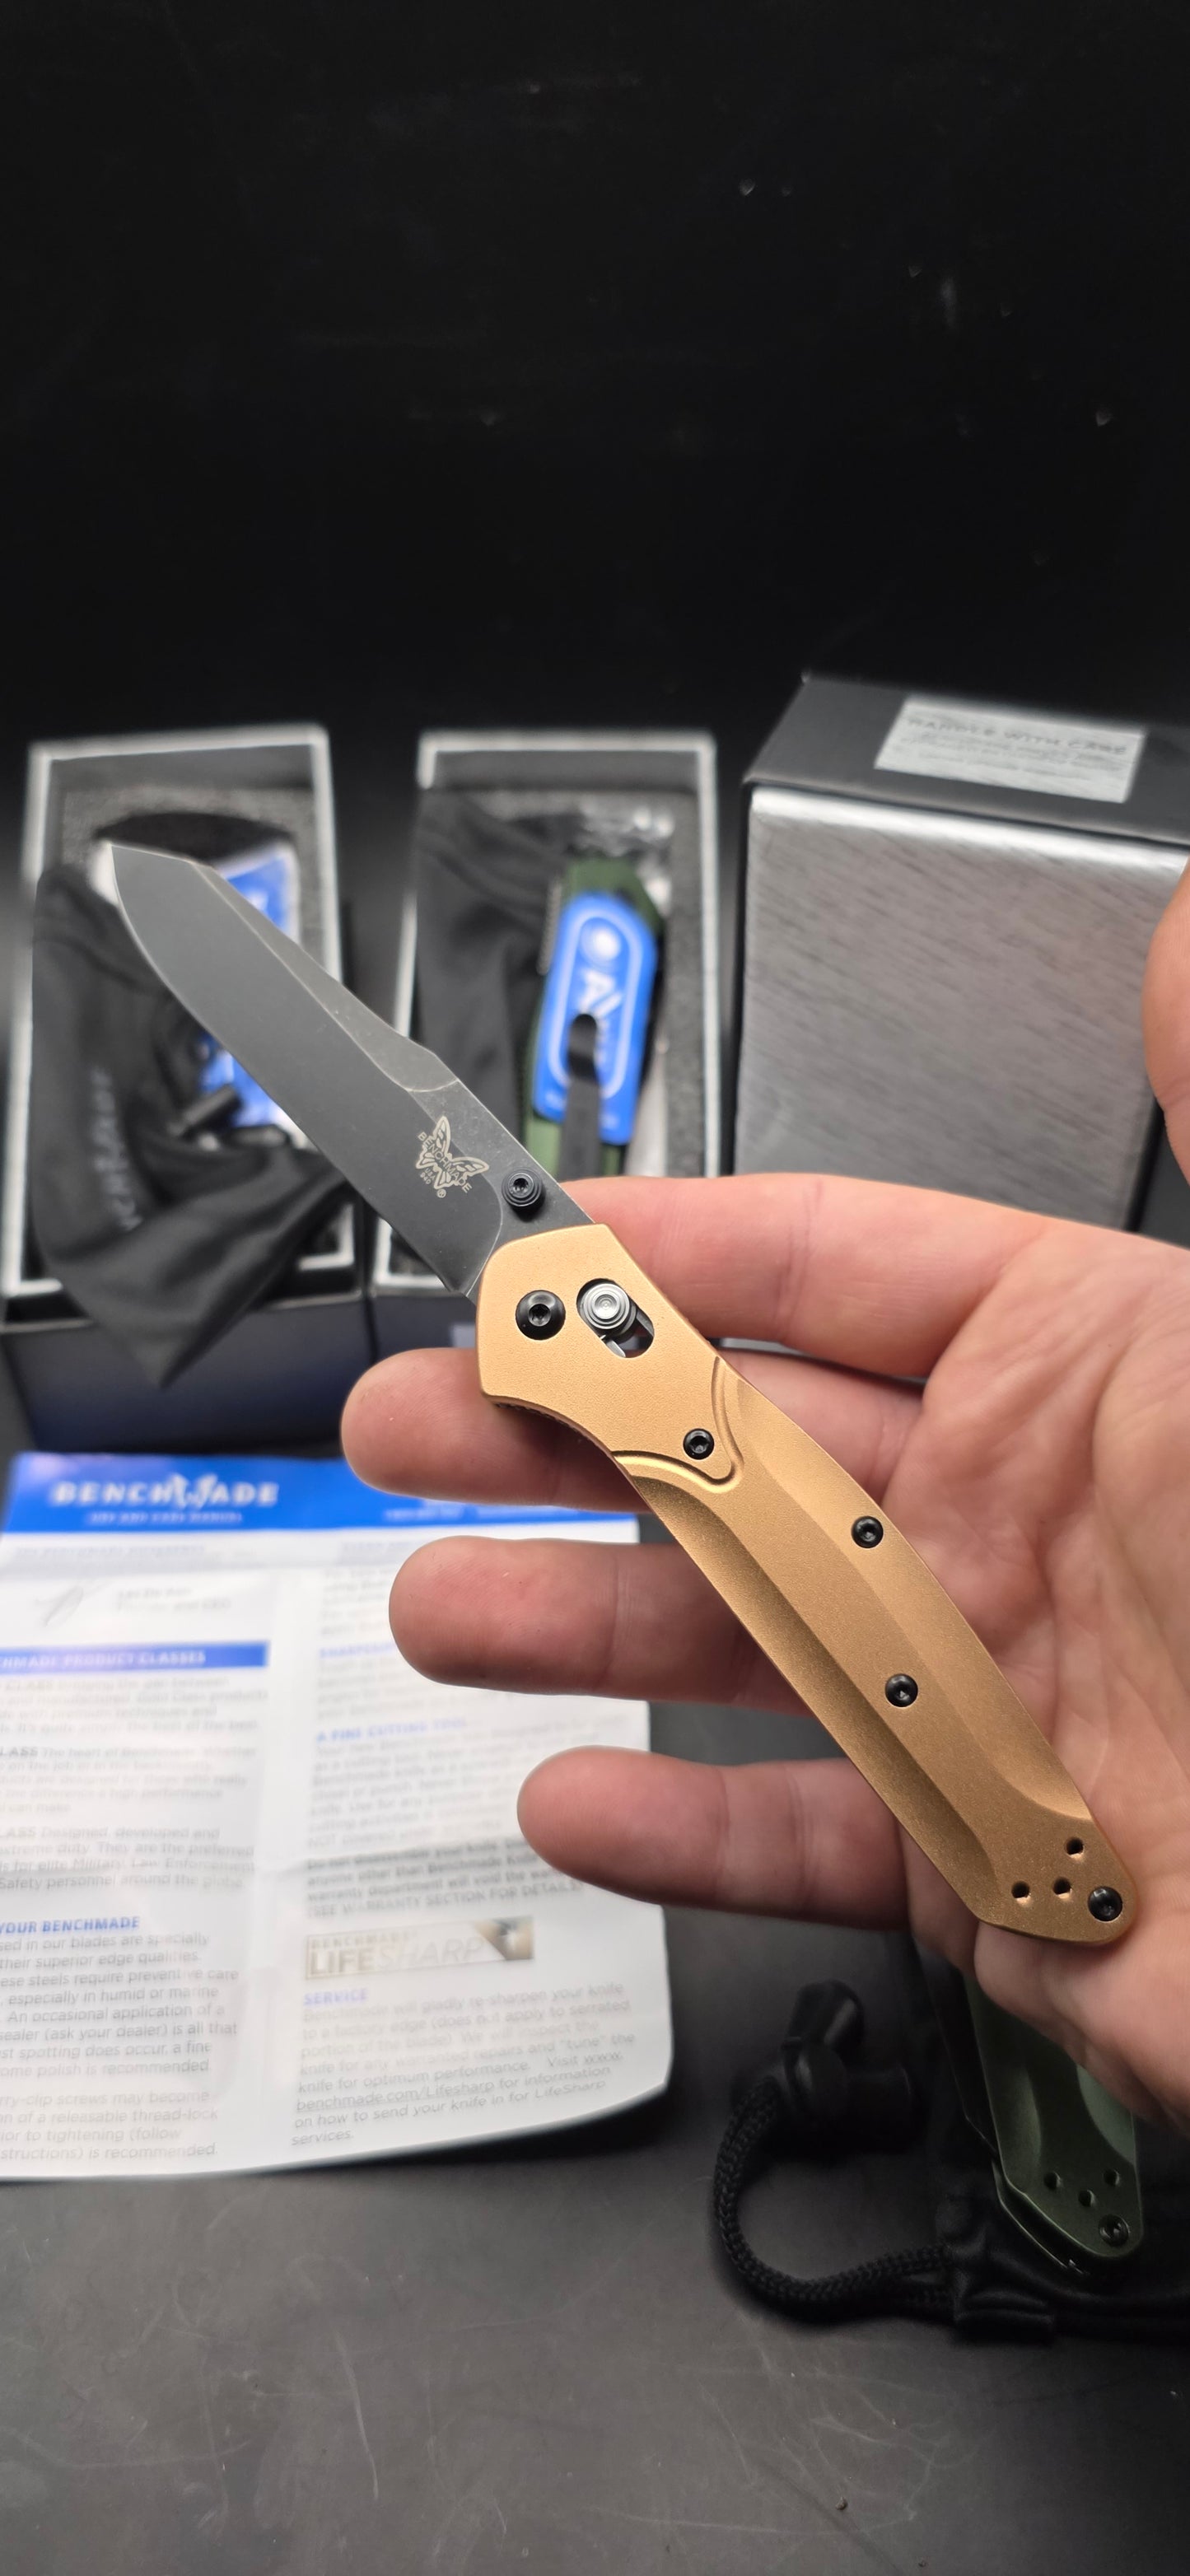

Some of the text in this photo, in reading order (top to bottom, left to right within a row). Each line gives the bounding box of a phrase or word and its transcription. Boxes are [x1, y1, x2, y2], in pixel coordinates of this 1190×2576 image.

[1003, 730, 1060, 746] WITH
[1067, 740, 1127, 755] CARE
[418, 1132, 473, 1193] BENCHMADE
[193, 1826, 221, 1839] and
[134, 1842, 158, 1853] are
[161, 1841, 185, 1853] the
[46, 1873, 117, 1892] personnel
[120, 1872, 171, 1886] around
[175, 1872, 198, 1885] the
[42, 1916, 140, 1933] BENCHMADE
[26, 1938, 39, 1951] in
[43, 1939, 66, 1950] our
[71, 1935, 117, 1949] blades
[121, 1935, 144, 1947] are
[35, 1954, 94, 1970] superior
[98, 1952, 134, 1967] edge
[28, 1972, 71, 1986] steels
[74, 1971, 124, 1987] require
[208, 1968, 240, 1981] care
[8, 1984, 220, 2007] especially in humid or marine
[303, 1987, 369, 2006] SERVICE
[552, 1986, 583, 2002] your
[588, 1981, 624, 1996] knife
[7, 2001, 226, 2023] An occasional application of a
[44, 2025, 75, 2042] (ask
[79, 2025, 113, 2042] your
[116, 2022, 168, 2040] dealer)
[172, 2021, 184, 2034] is
[188, 2019, 204, 2035] all
[208, 2020, 239, 2036] that
[390, 2018, 427, 2033] edge
[19, 2044, 81, 2061] spotting
[86, 2042, 121, 2056] does
[173, 2043, 182, 2054] a
[186, 2038, 212, 2055] fine
[528, 2041, 556, 2055] and
[37, 2062, 82, 2079] polish
[86, 2060, 97, 2075] is
[298, 2078, 334, 2094] knife
[338, 2075, 358, 2090] for
[363, 2070, 431, 2089] optimum
[433, 2060, 531, 2082] performance.
[546, 2053, 579, 2068] Visit
[499, 2075, 521, 2090] for
[524, 2065, 611, 2087] information
[57, 2093, 108, 2106] screws
[113, 2093, 145, 2106] may
[150, 2089, 211, 2104] become
[294, 2077, 607, 2130] on how to send your knife in for LifeSharp
[17, 2106, 219, 2124] of a releasable thread-lock
[26, 2128, 42, 2141] to
[47, 2126, 124, 2144] tightening
[129, 2125, 183, 2142] (follow
[291, 2127, 354, 2148] services.
[89, 2145, 100, 2159] is
[105, 2141, 218, 2159] recommended.
